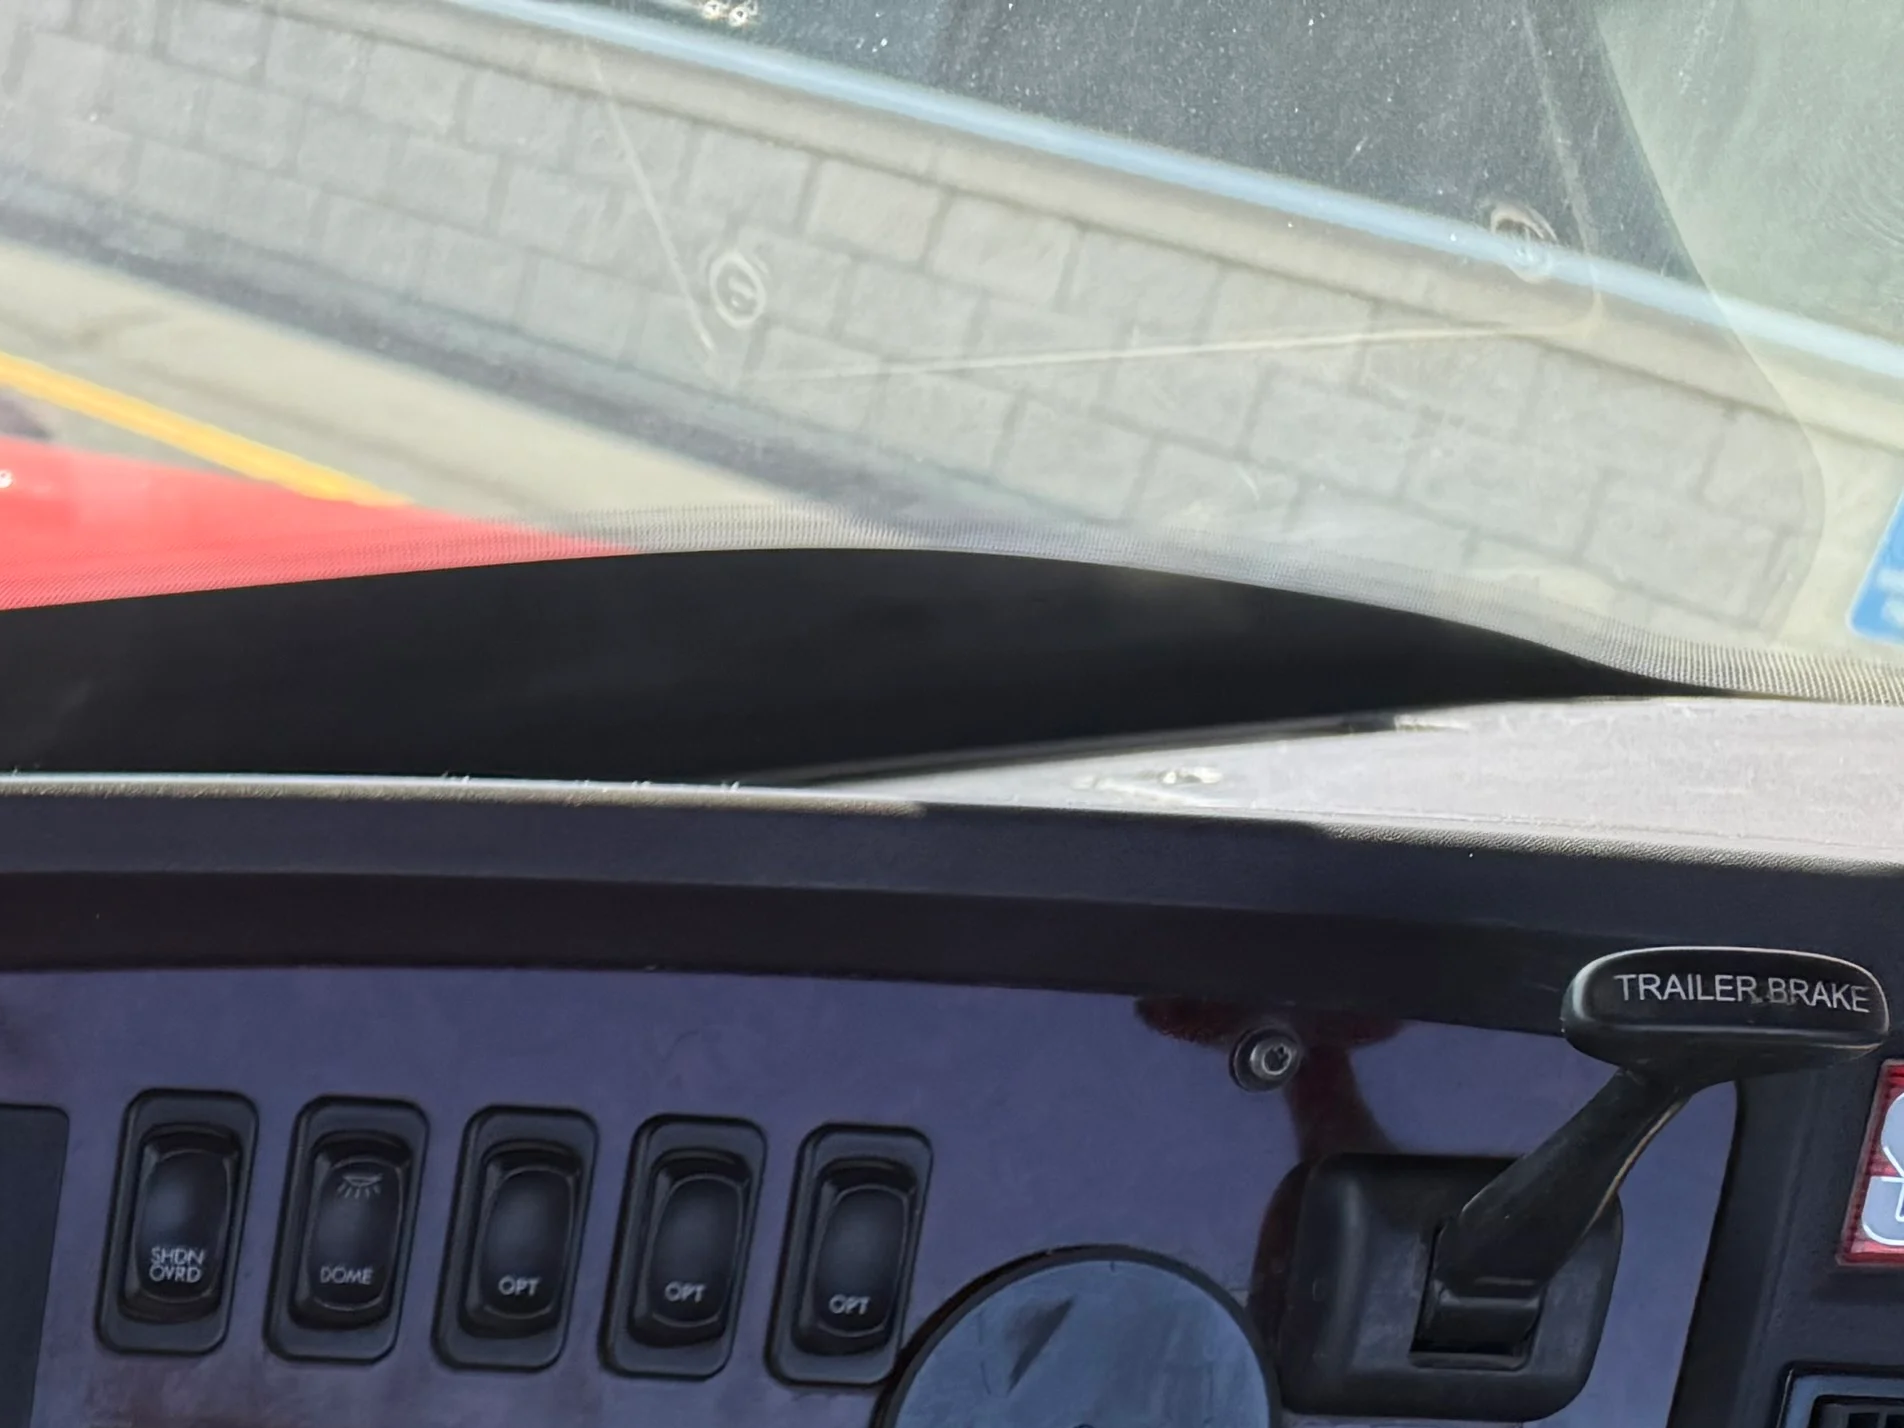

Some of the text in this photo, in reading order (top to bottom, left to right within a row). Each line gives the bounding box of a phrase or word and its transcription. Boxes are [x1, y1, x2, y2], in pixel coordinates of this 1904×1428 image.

[1613, 973, 1870, 1014] TRAILER BRAKE
[149, 1246, 205, 1264] SHDN
[148, 1263, 203, 1284] OVRD
[319, 1265, 375, 1286] DOME
[497, 1274, 541, 1297] OPT
[664, 1280, 708, 1304] OPT
[827, 1294, 870, 1316] OPT
